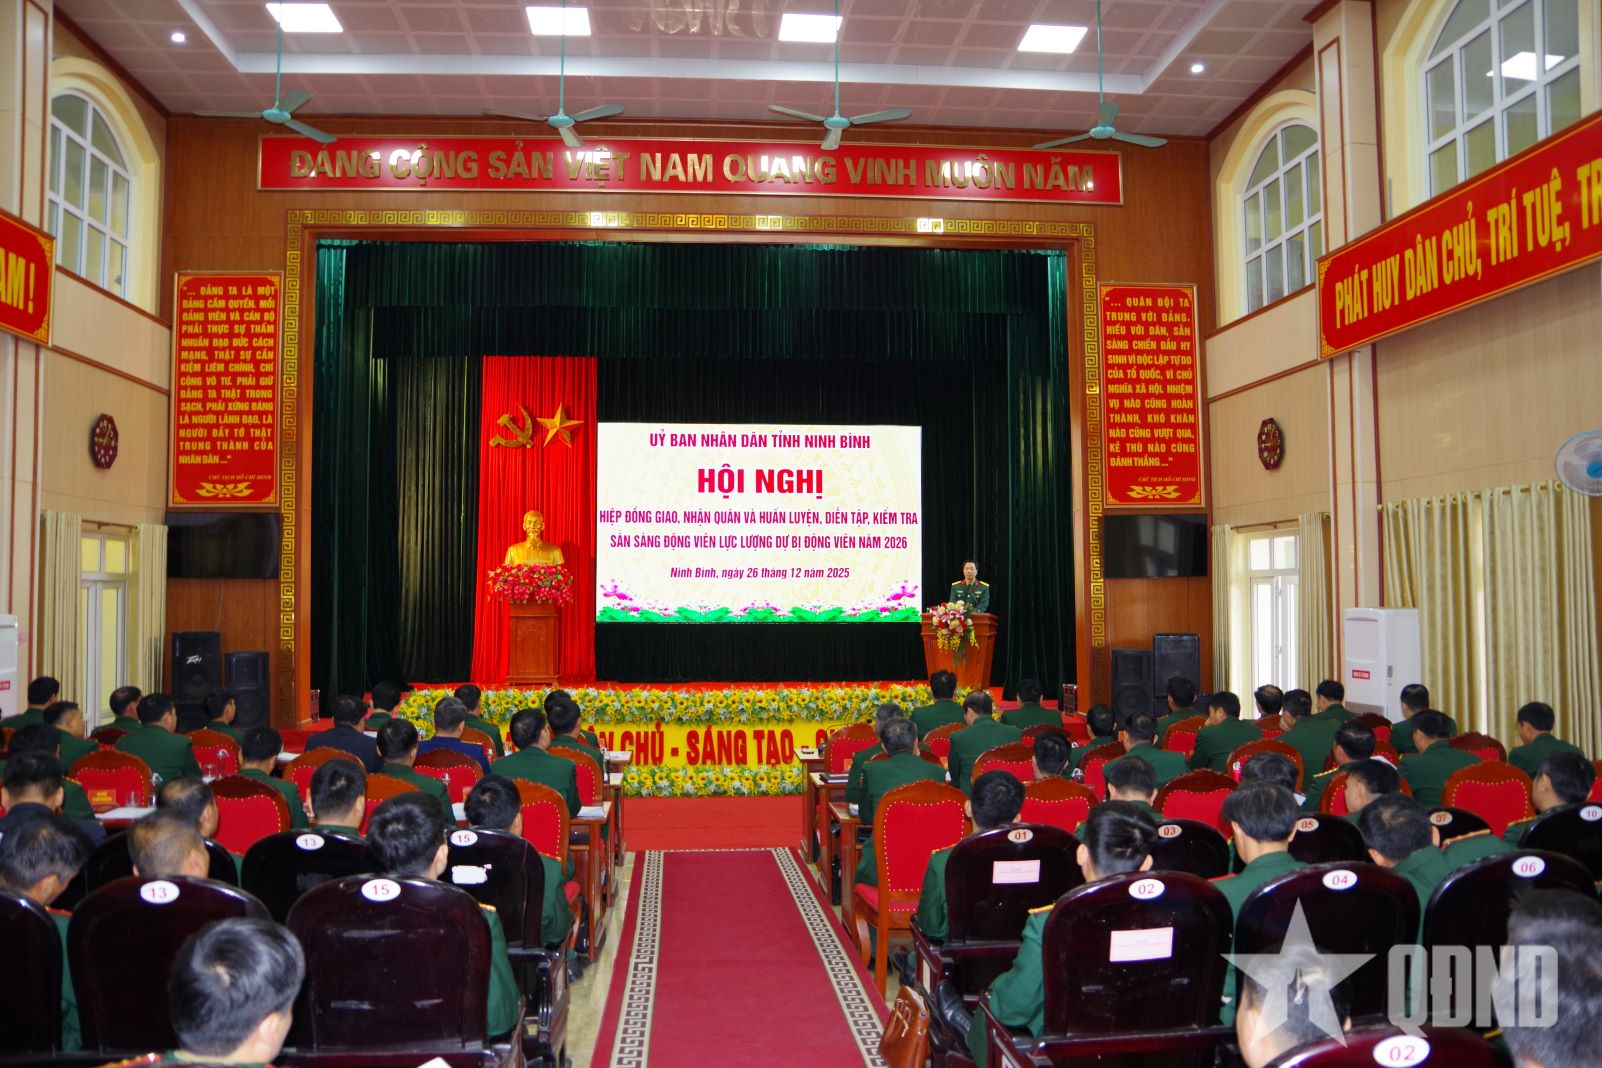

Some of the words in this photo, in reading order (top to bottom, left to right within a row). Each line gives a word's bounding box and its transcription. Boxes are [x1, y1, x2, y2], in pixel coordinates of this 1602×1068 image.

[389, 142, 478, 186] CỘNG
[488, 140, 553, 179] SẢN
[564, 144, 630, 187] VIỆT
[639, 152, 713, 182] NAM
[722, 153, 837, 184] QUANG
[844, 157, 917, 185] VINH
[925, 153, 1015, 189] MUÔN
[1023, 156, 1094, 192] NĂM
[1336, 264, 1368, 328] PHÁT
[1372, 254, 1400, 314] HUY
[1404, 234, 1438, 301] DÂN
[1442, 200, 1482, 285] CHỦ,
[1487, 187, 1518, 266] TRÍ
[1522, 167, 1570, 252] TUỆ,
[229, 286, 237, 295] TA
[242, 285, 252, 295] LÀ
[1126, 296, 1152, 307] QUÂN
[1179, 299, 1189, 307] TA
[230, 311, 240, 320] VÀ
[1106, 312, 1136, 321] TRUNG
[1181, 342, 1190, 350] HY
[1108, 355, 1127, 364] SINH
[1181, 356, 1191, 364] DO
[208, 390, 216, 398] TA
[246, 390, 272, 398] TRONG
[180, 414, 189, 424] LÀ
[263, 414, 272, 424] LÀ
[650, 428, 666, 446] UỶ
[670, 434, 696, 447] BAN
[701, 431, 736, 447] NHÂN
[741, 432, 767, 448] DÂN
[772, 430, 800, 448] TỈNH
[805, 435, 836, 448] NINH
[840, 432, 870, 448] BÌNH
[180, 442, 211, 450] TRUNG
[698, 464, 744, 499] HỘI
[756, 469, 822, 499] NGHỊ
[600, 508, 622, 525] HIỆP
[655, 511, 680, 524] GIAO,
[684, 508, 710, 526] NHẬN
[714, 508, 740, 525] QUÂN
[744, 508, 756, 524] VÀ
[760, 507, 786, 524] HUẤN
[900, 512, 918, 524] TRA
[634, 532, 660, 548] SÀNG
[664, 533, 690, 550] ĐỘNG
[694, 533, 716, 548] VIÊN
[720, 535, 737, 551] LỰC
[741, 535, 772, 551] LƯỢNG
[776, 535, 790, 551] DỰ
[792, 536, 800, 551] BỊ
[804, 533, 830, 551] ĐỘNG
[834, 533, 856, 548] VIÊN
[859, 534, 881, 548] NĂM
[884, 536, 908, 548] 2026
[671, 567, 692, 578] Ninh
[695, 567, 718, 578] Bình,
[722, 567, 744, 579] ngày
[747, 568, 758, 578] 26
[762, 568, 787, 580] tháng
[791, 568, 801, 578] 12
[804, 568, 824, 578] năm
[827, 568, 850, 578] 2025
[620, 720, 664, 766] CHỦ
[686, 724, 747, 766] SÁNG
[753, 729, 794, 768] TẠO
[1436, 814, 1446, 822] 07
[1587, 810, 1597, 818] 10
[1302, 820, 1312, 829] 05
[1015, 832, 1026, 840] 01
[1164, 827, 1176, 836] 03
[305, 838, 316, 847] 13
[458, 834, 470, 843] 15
[1520, 863, 1536, 873] 06
[1332, 875, 1348, 886] 04
[151, 886, 167, 900] 13
[373, 884, 390, 896] 15
[1138, 884, 1155, 894] 02
[1390, 1044, 1415, 1062] 02
